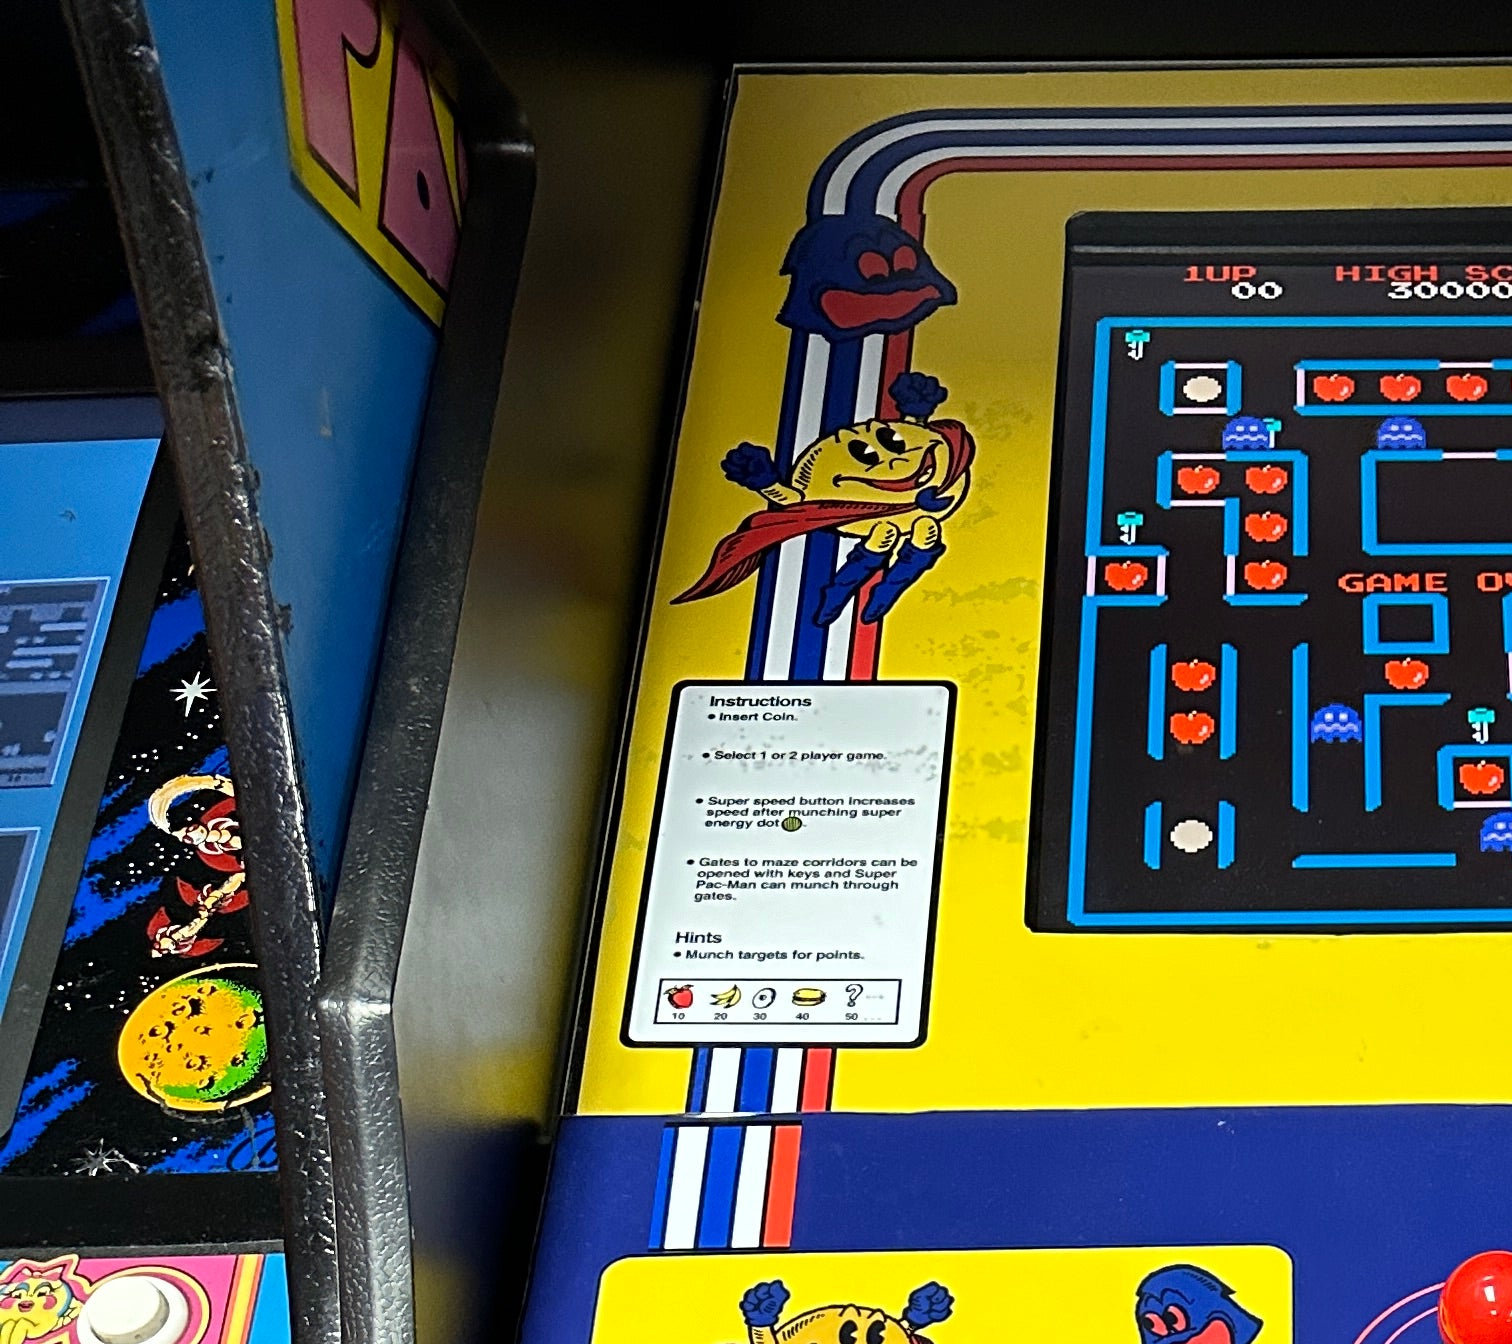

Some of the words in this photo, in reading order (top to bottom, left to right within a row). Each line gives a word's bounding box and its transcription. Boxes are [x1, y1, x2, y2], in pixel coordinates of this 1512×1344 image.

[1183, 265, 1257, 282] 1UP
[1336, 265, 1438, 282] HIGH
[1232, 282, 1283, 300] 00
[1338, 573, 1448, 592] GAME
[710, 696, 812, 707] Instructions
[719, 712, 758, 721] Insert
[763, 712, 798, 721] Coin.
[714, 751, 756, 760] Select
[761, 751, 766, 760] 1
[789, 751, 798, 760] 2
[801, 751, 843, 762] player
[846, 752, 887, 762] game.
[708, 797, 750, 807] Super
[753, 797, 795, 807] speed
[800, 797, 844, 806] button
[849, 797, 915, 806] increases
[707, 808, 748, 818] speed
[753, 808, 784, 817] after
[789, 808, 857, 818] munching
[862, 809, 902, 819] super
[705, 820, 752, 830] energy
[757, 819, 779, 827] dot
[699, 858, 739, 867] Gates
[744, 858, 758, 867] to
[762, 859, 799, 867] maze
[802, 858, 867, 867] corridors
[871, 859, 896, 867] can
[900, 858, 917, 867] be
[697, 870, 749, 880] opened
[754, 869, 783, 878] with
[788, 869, 820, 880] keys
[824, 869, 850, 878] and
[854, 869, 897, 880] Super
[696, 881, 756, 890] Pac-Man
[760, 882, 786, 890] can
[791, 880, 839, 890] munch
[843, 880, 899, 892] through
[694, 892, 737, 903] gates.
[675, 932, 722, 944] Hints
[686, 950, 733, 960] Munch
[738, 950, 788, 962] targets
[792, 950, 811, 960] for
[815, 950, 865, 962] points.
[672, 1012, 685, 1021] 10
[714, 1012, 728, 1021] 20
[753, 1012, 767, 1021] 30
[795, 1012, 810, 1021] 40
[845, 1012, 858, 1021] 50
